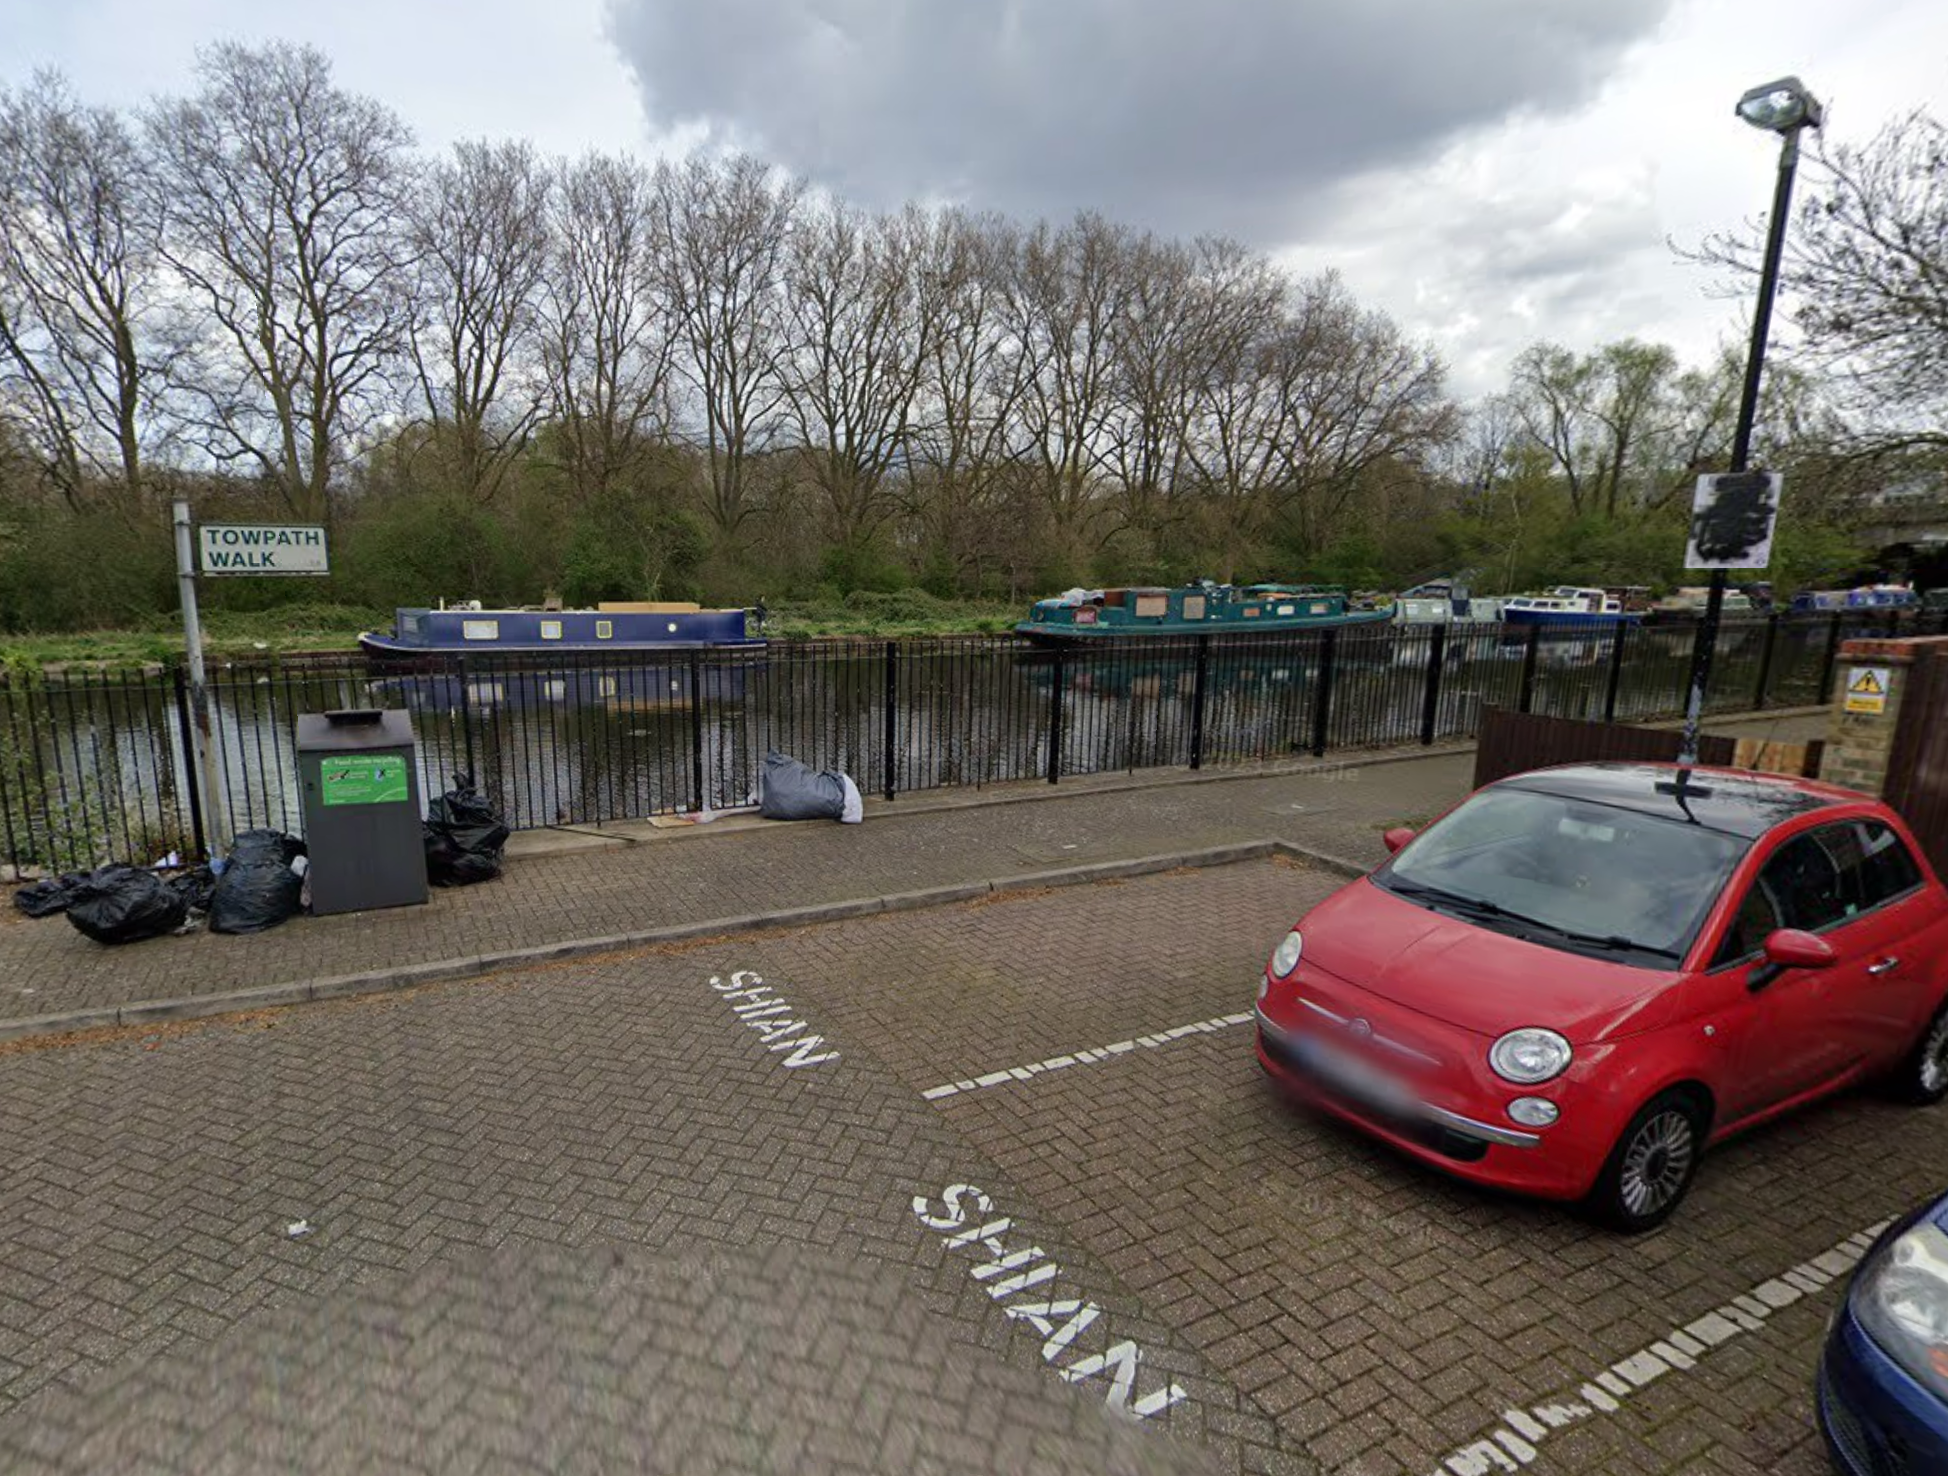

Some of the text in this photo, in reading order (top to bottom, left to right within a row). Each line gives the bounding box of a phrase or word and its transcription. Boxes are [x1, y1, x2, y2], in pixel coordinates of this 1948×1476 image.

[206, 529, 320, 546] TOWPATH
[208, 551, 276, 568] WALK
[709, 970, 841, 1068] SHIAN
[911, 1183, 1188, 1420] SHIAN
